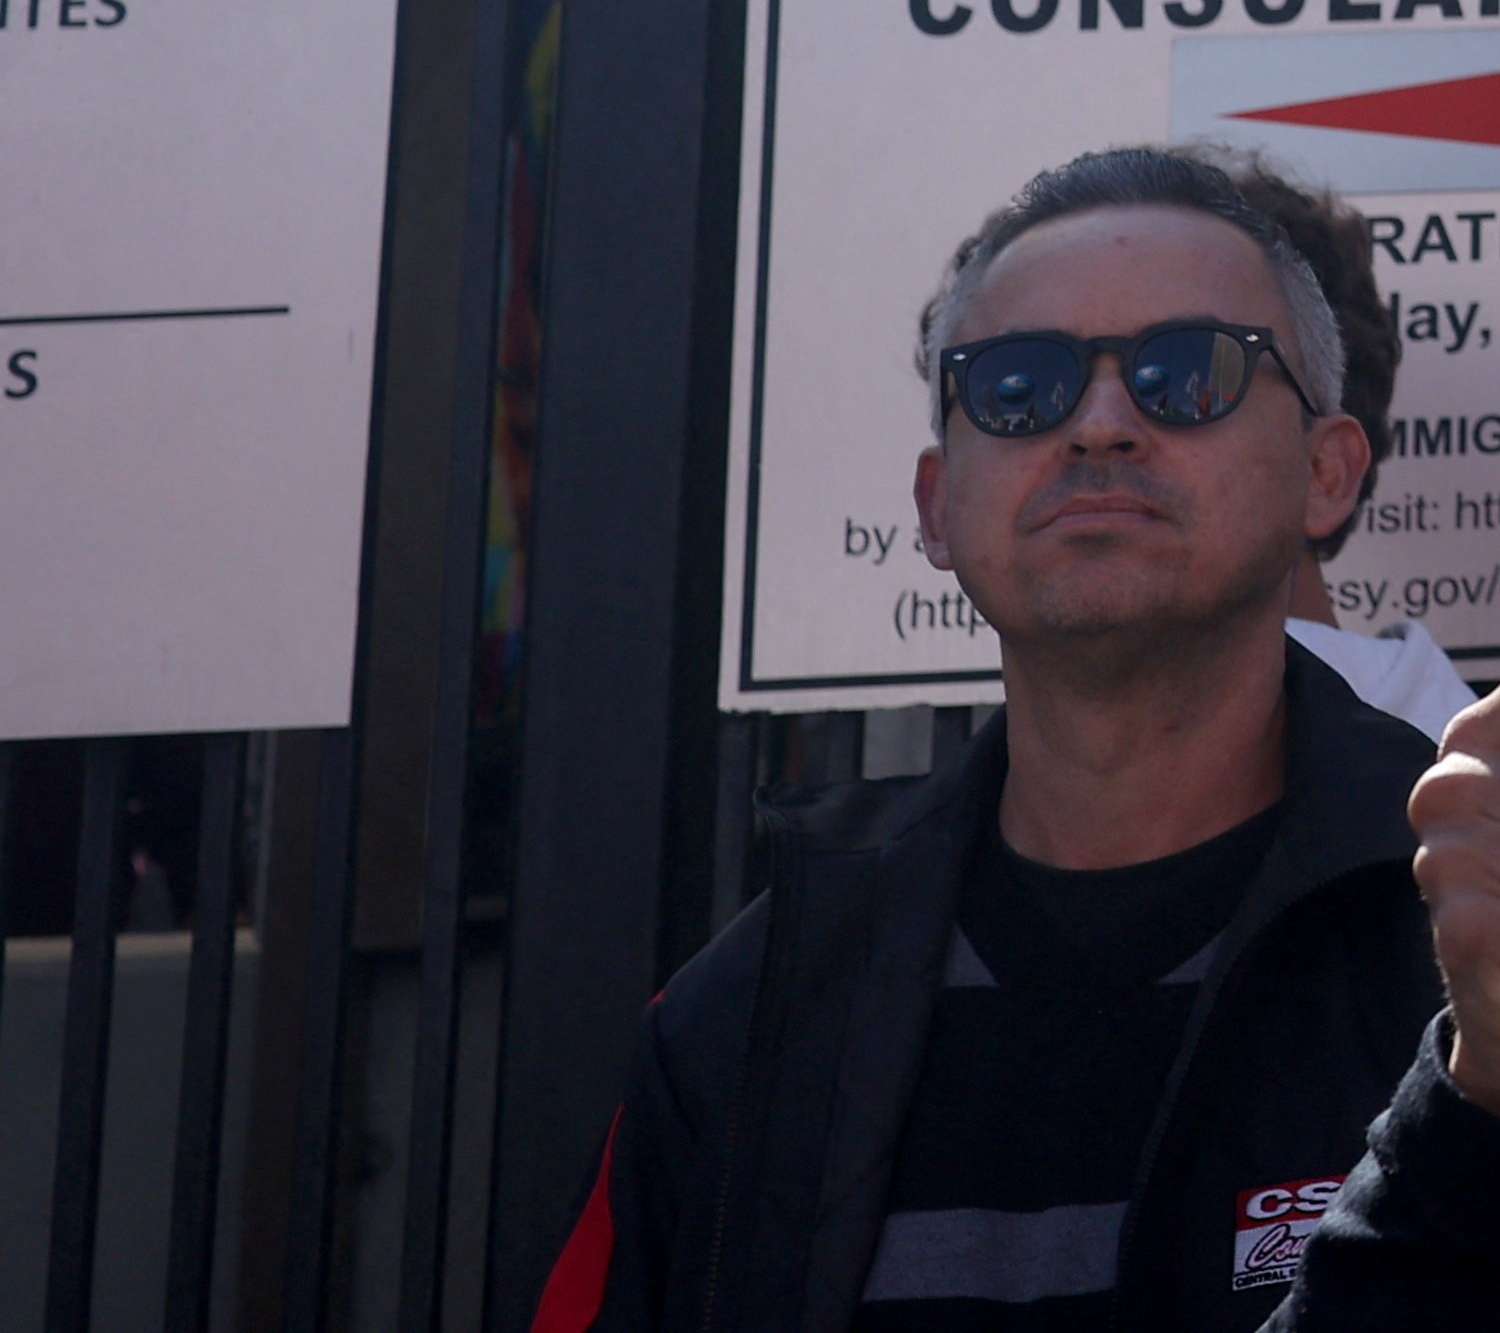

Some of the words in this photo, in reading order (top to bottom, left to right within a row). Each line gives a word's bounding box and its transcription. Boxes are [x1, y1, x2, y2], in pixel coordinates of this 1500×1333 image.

[844, 516, 897, 566] by
[1358, 492, 1440, 534] isit:
[1245, 1181, 1342, 1220] CS
